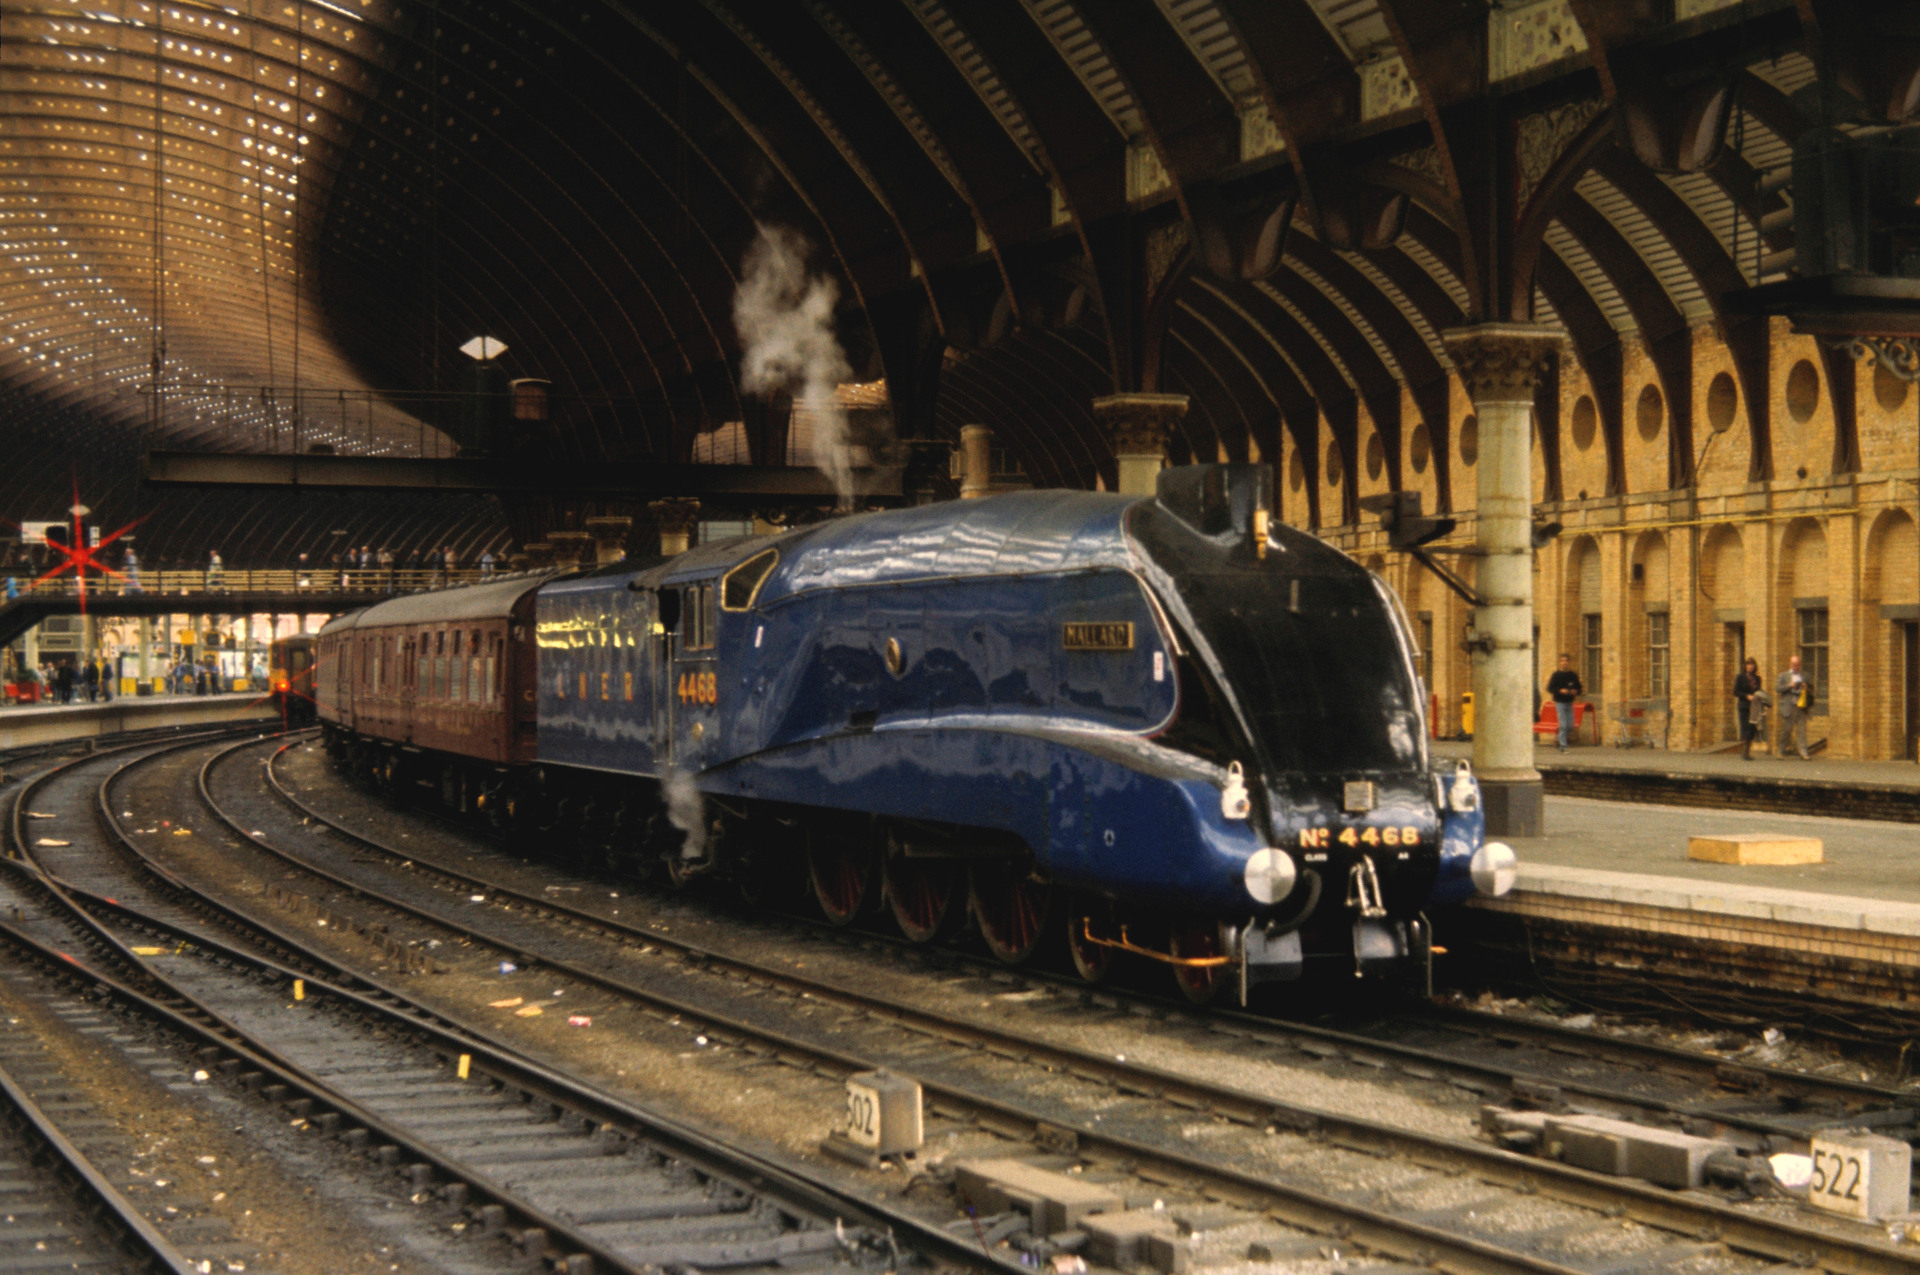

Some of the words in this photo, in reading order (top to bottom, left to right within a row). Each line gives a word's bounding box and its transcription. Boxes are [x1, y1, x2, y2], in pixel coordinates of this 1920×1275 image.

[1066, 625, 1126, 647] MALLARD
[677, 672, 717, 705] 4468
[1338, 826, 1420, 848] 4468
[1812, 1149, 1861, 1201] 522
